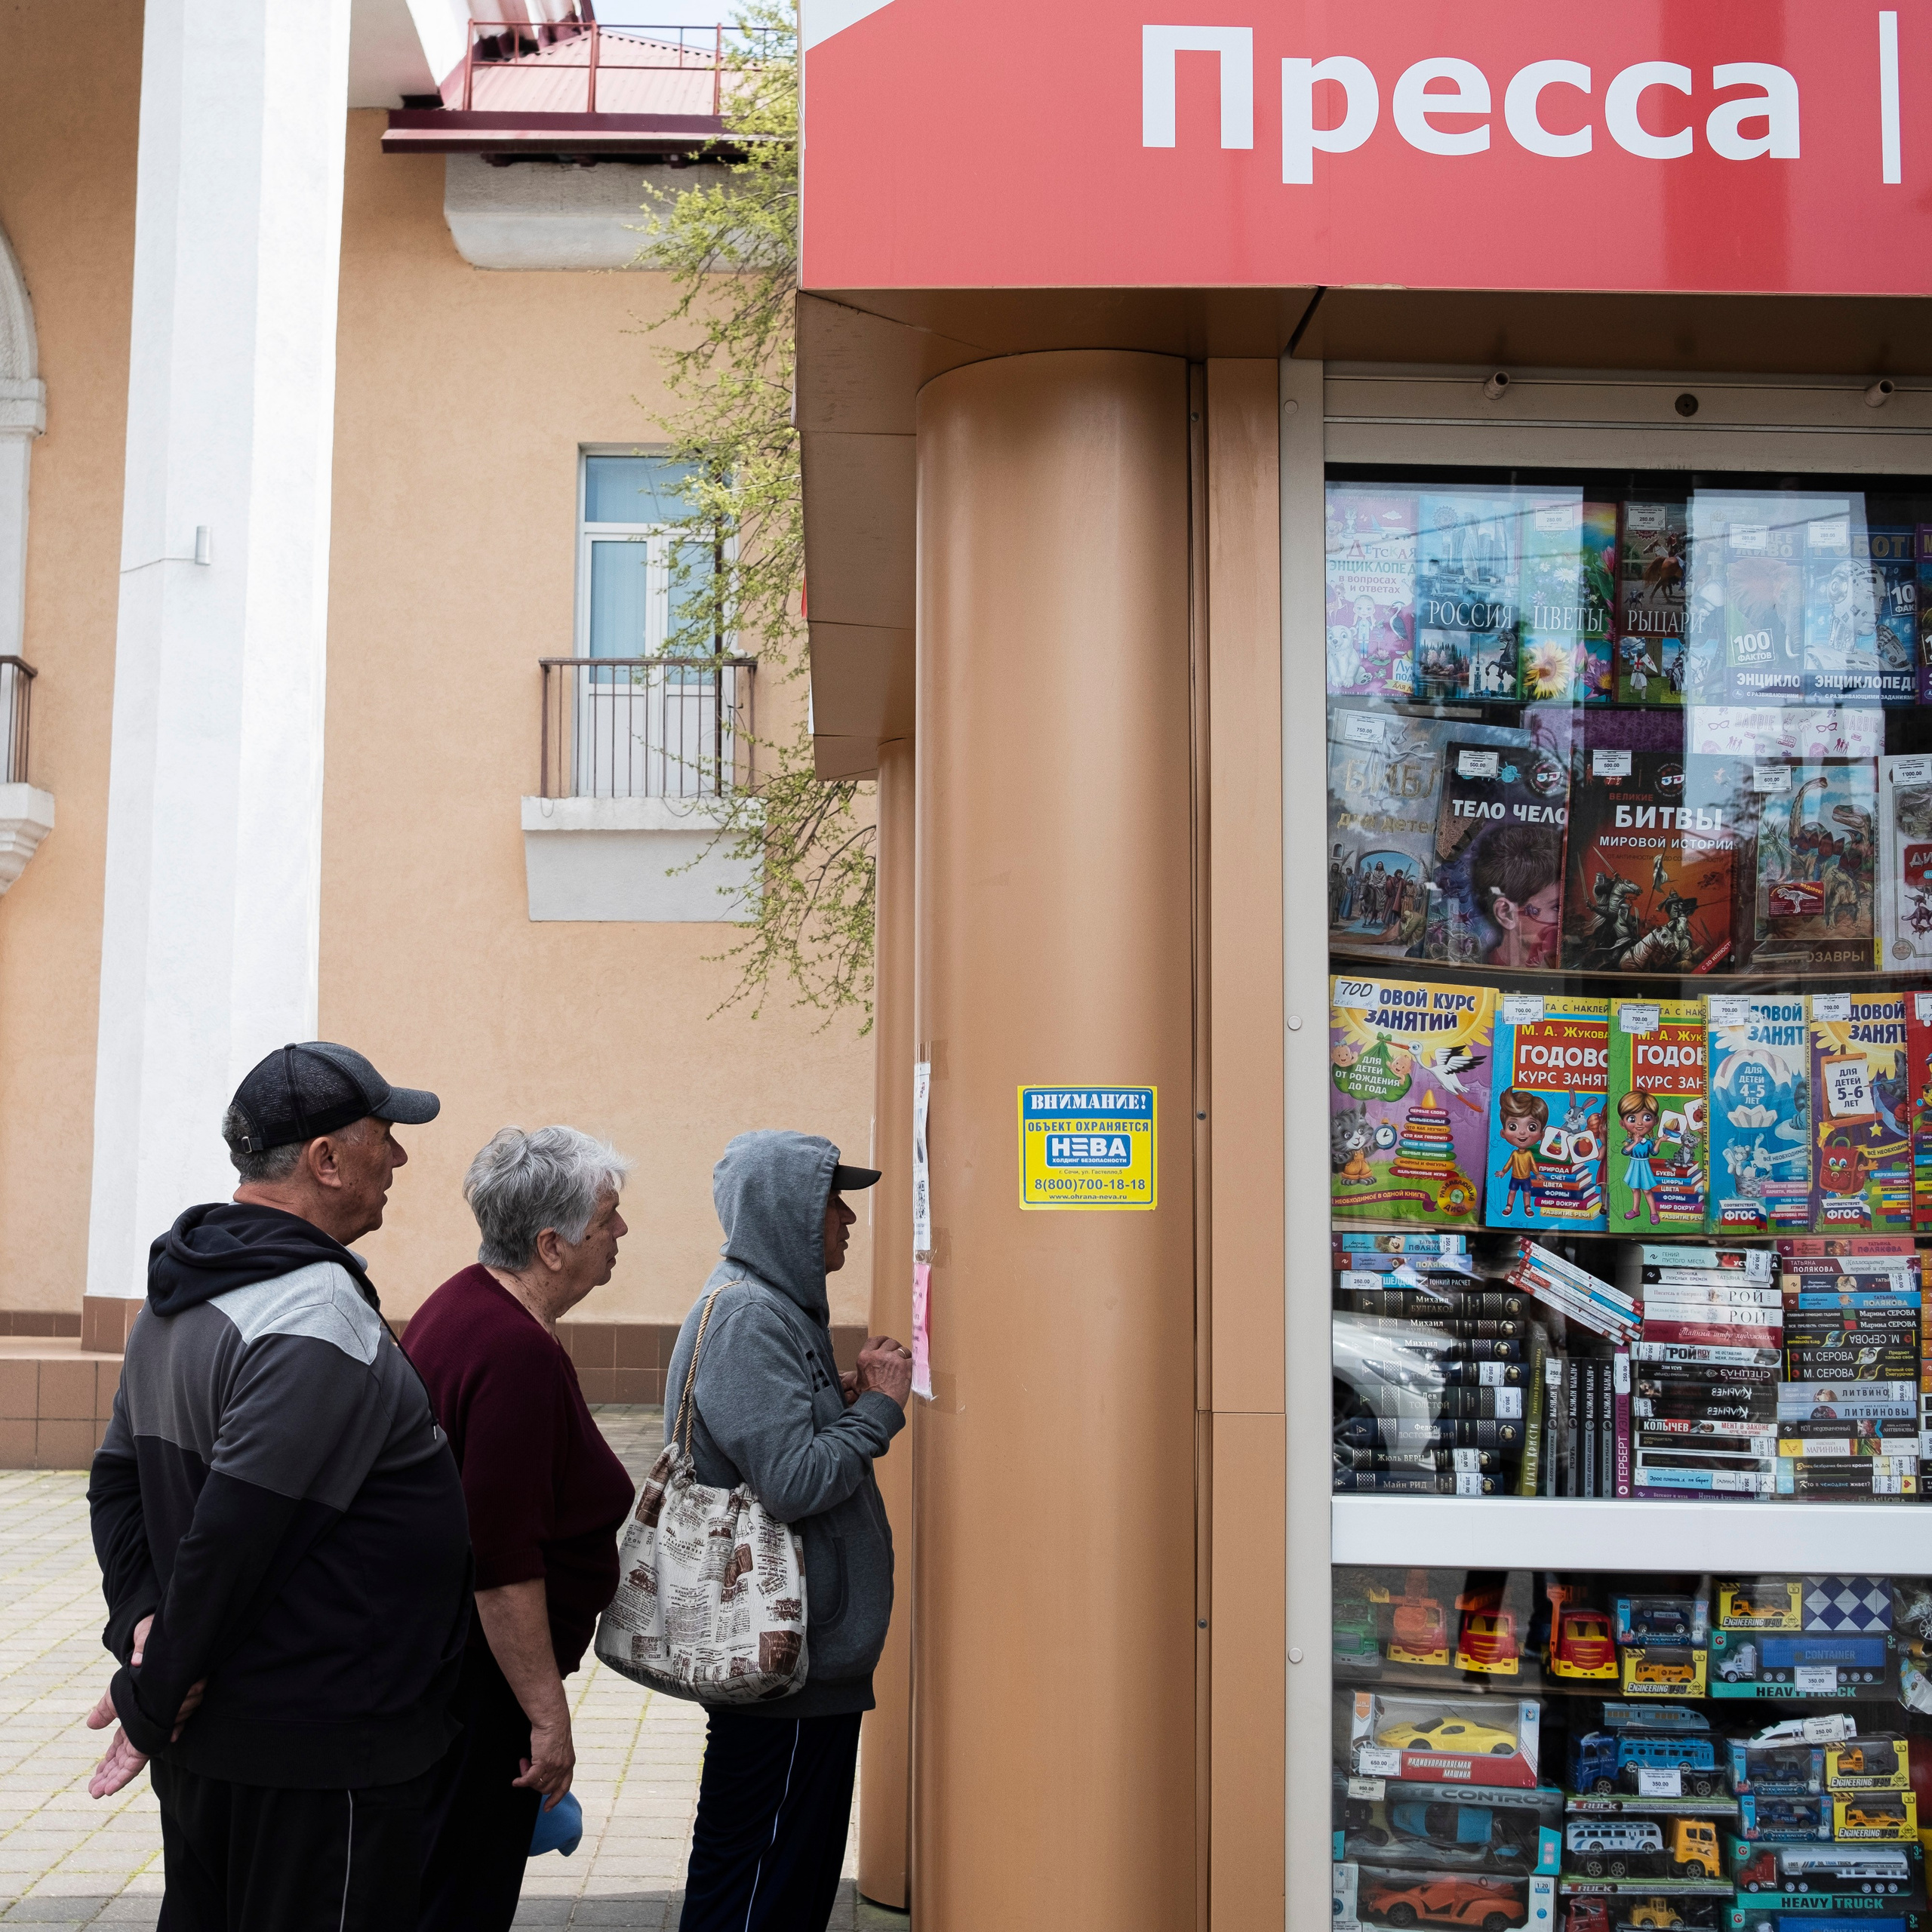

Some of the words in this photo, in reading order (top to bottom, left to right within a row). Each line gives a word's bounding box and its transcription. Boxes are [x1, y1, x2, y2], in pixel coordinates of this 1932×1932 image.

[1142, 24, 1800, 185] Пресса
[1348, 576, 1397, 585] вопросах
[1359, 585, 1400, 594] ответах
[1429, 600, 1513, 629] РОССИЯ
[1532, 605, 1604, 632] ЦВЕТЫ
[1627, 609, 1703, 635] РЫЦАРИ
[1733, 631, 1770, 653] 100
[1737, 651, 1772, 662] ФАКТОВ
[1736, 672, 1801, 689] ЭНЦИКЛО
[1735, 712, 1776, 731] BARBIE
[1842, 714, 1880, 734] BARBIE
[1609, 792, 1654, 802] ВЕЛИКИЕ
[1452, 799, 1506, 820] ТЕЛО
[1512, 804, 1568, 824] ЧЕЛО
[1615, 805, 1723, 831] БИТВЫ
[1599, 835, 1666, 848] МИРОВОЙ
[1671, 838, 1734, 851] ИСТОРИИ
[1340, 981, 1374, 998] 700
[1433, 991, 1475, 1012] КУРС
[1364, 1009, 1458, 1032] ЗАНЯТИЙ
[1521, 1025, 1538, 1037] М.
[1543, 1026, 1557, 1037] А.
[1660, 1030, 1672, 1041] А.
[1747, 1026, 1805, 1046] ЗАНЯТ
[1362, 1055, 1382, 1066] ДЛЯ
[1355, 1063, 1383, 1075] ДЕТЕЙ
[1744, 1066, 1762, 1075] ДЛЯ
[1839, 1068, 1857, 1078] ДЛЯ
[1335, 1070, 1346, 1079] ОТ
[1349, 1072, 1400, 1087] РОЖДЕНИЯ
[1518, 1070, 1556, 1084] КУРС
[1636, 1075, 1672, 1088] КУРС
[1739, 1075, 1764, 1085] ДЕТЕЙ
[1835, 1075, 1862, 1087] ДЕТЕЙ
[1348, 1081, 1361, 1091] ДО
[1364, 1084, 1387, 1094] ГОДА
[1740, 1085, 1765, 1098] 4-5
[1837, 1086, 1863, 1100] 5-6
[1031, 1094, 1146, 1110] ВНИМАНИЕ!
[1744, 1097, 1760, 1105] ЛЕТ
[1844, 1099, 1860, 1108] ЛЕТ
[1028, 1121, 1072, 1131] ОБЪЕКТ
[1075, 1121, 1149, 1131] ОХРАНЯЕТСЯ
[1051, 1137, 1127, 1156] НЕВА
[1539, 1166, 1570, 1174] ПРИРОДА
[1035, 1179, 1146, 1192] 8(800)700-18-18
[1661, 1177, 1684, 1186] ЦИФРЫ
[1334, 1193, 1377, 1204] НЕОБХОДИМОЕ
[1383, 1191, 1404, 1199] ОДНОЙ
[1404, 1190, 1426, 1199] КНИГЕ!
[1545, 1189, 1570, 1198] ФОРМЫ
[1542, 1209, 1573, 1217] РАЗВИТИЕ
[1724, 1209, 1756, 1222] ФГОС
[1826, 1208, 1860, 1221] ФГОС
[1383, 1276, 1415, 1286] ШЕЛДОН
[1451, 1278, 1471, 1287] РАСЧЕТ
[1416, 1295, 1449, 1303] Михаил
[1729, 1290, 1764, 1303] РОЙ
[1411, 1304, 1454, 1313] БУЛГАКОВ
[1730, 1309, 1766, 1324] РОЙ
[1679, 1327, 1710, 1337] Тайный
[1714, 1330, 1734, 1341] шифр
[1735, 1331, 1776, 1342] художника
[1404, 1339, 1438, 1347] Михаил
[1669, 1346, 1697, 1359] РОЙ
[1803, 1352, 1814, 1361] М.
[1816, 1352, 1854, 1361] СЕРОВА
[1720, 1369, 1770, 1378] СПЕЦНАЗ
[1804, 1369, 1813, 1378] М.
[1817, 1368, 1855, 1378] СЕРОВА
[1409, 1400, 1450, 1409] ТОЛСТОЙ
[1586, 1392, 1594, 1419] КРИСТИ
[1603, 1392, 1611, 1419] КРИСТИ
[1618, 1398, 1628, 1435] УЭЛЛС
[1844, 1408, 1909, 1417] ЛИТВИНОВЫ
[1414, 1423, 1438, 1432] Федор
[1644, 1420, 1689, 1432] КОЛЫЧЕВ
[1377, 1454, 1401, 1462] Жюль
[1618, 1435, 1628, 1482] ГЕРБЕРТ
[1383, 1480, 1407, 1488] Майн
[1799, 1481, 1814, 1489] Кто
[1722, 1617, 1764, 1628] ENGINEERING
[1764, 1618, 1783, 1628] TEAM
[1887, 1635, 1896, 1645] 3+
[1804, 1650, 1857, 1660] CONTAINER
[1627, 1683, 1669, 1694] ENGINEERING
[1669, 1684, 1687, 1694] TEAM
[1407, 1757, 1472, 1770] РАДИОУПРАВЛЯЕМАЯ
[1442, 1769, 1472, 1780] МАШИНА
[1831, 1777, 1872, 1787] ENGINEERING
[1873, 1777, 1891, 1786] TEAM
[1441, 1789, 1555, 1806] CONTROL
[1574, 1800, 1617, 1810] TRUCK
[1838, 1828, 1880, 1838] ENGINEERING
[1881, 1829, 1899, 1838] TEAM
[1913, 1845, 1922, 1855] 3+
[1781, 1897, 1829, 1909] HEAVY
[1835, 1897, 1884, 1909] TRUCK
